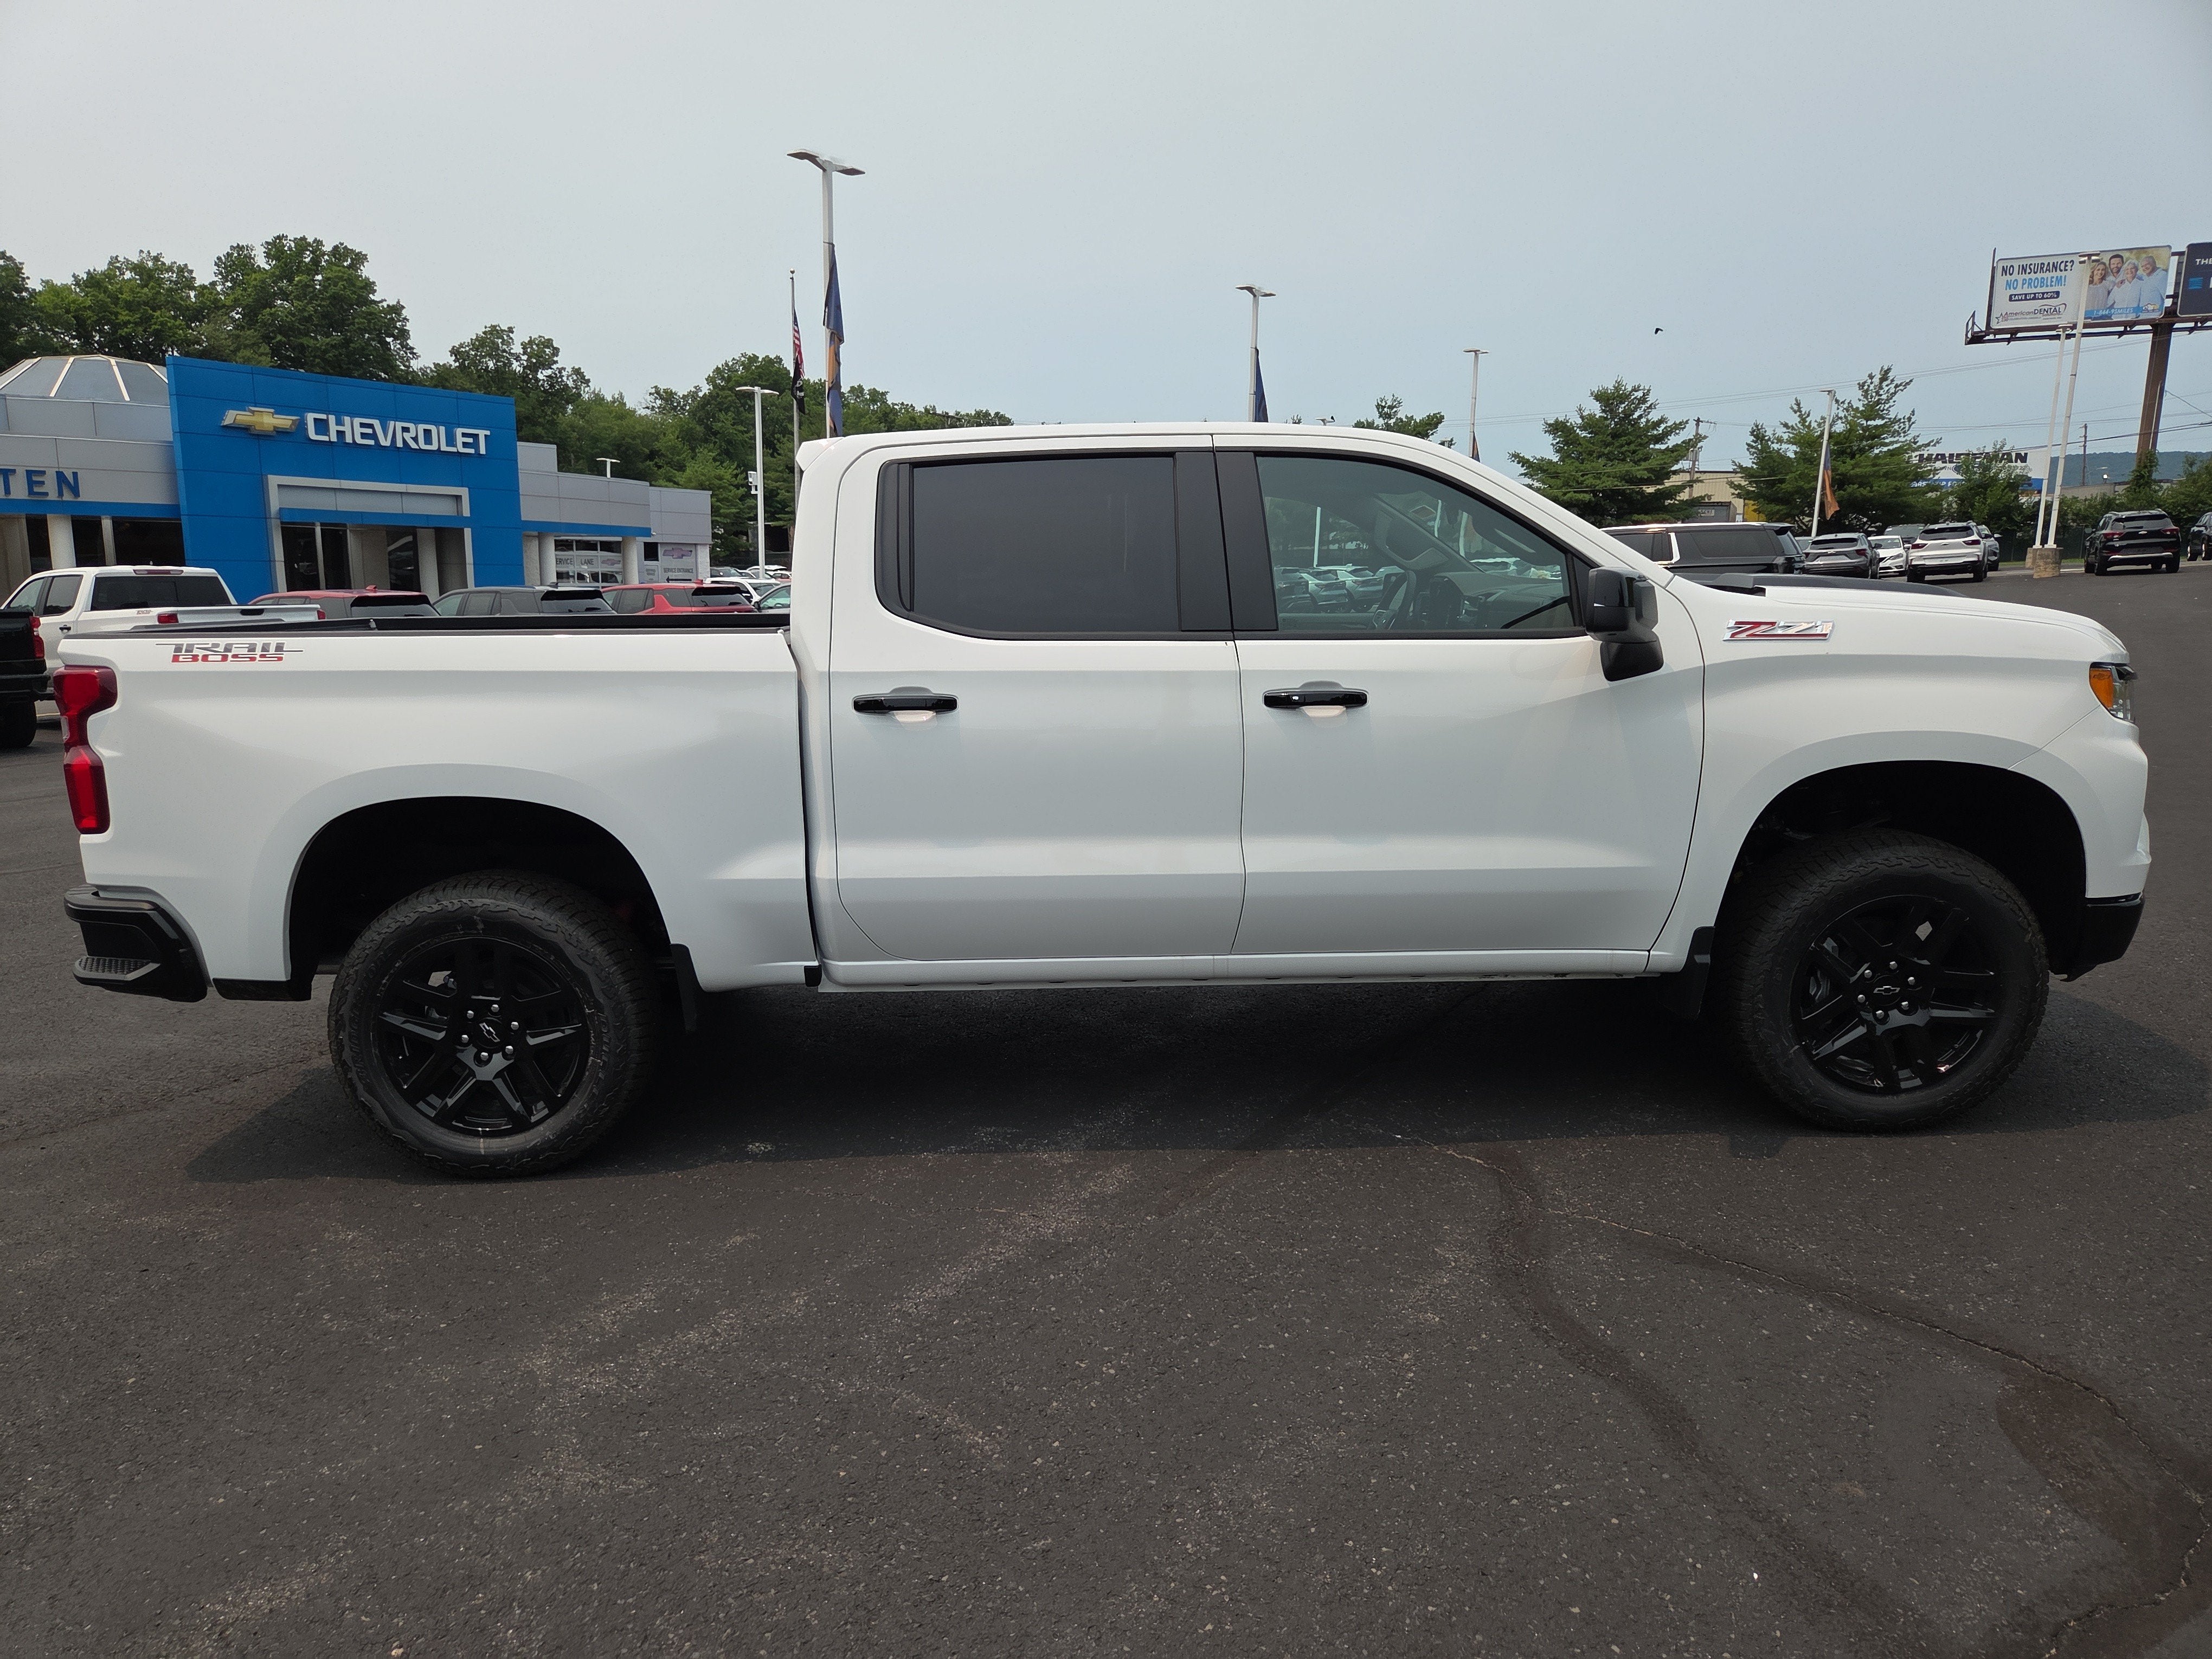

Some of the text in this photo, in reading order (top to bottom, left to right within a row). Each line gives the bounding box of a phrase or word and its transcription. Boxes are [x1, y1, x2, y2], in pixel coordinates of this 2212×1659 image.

[2001, 260, 2075, 276] NO INSURANCE?
[2005, 275, 2067, 291] NO PROBLEM!
[305, 412, 491, 454] CHEVROLET
[1918, 452, 2028, 464] HALAN
[0, 468, 80, 498] TEN
[1722, 620, 1833, 641] Z71
[156, 642, 304, 653] TRAIL
[171, 653, 285, 663] BOSS
